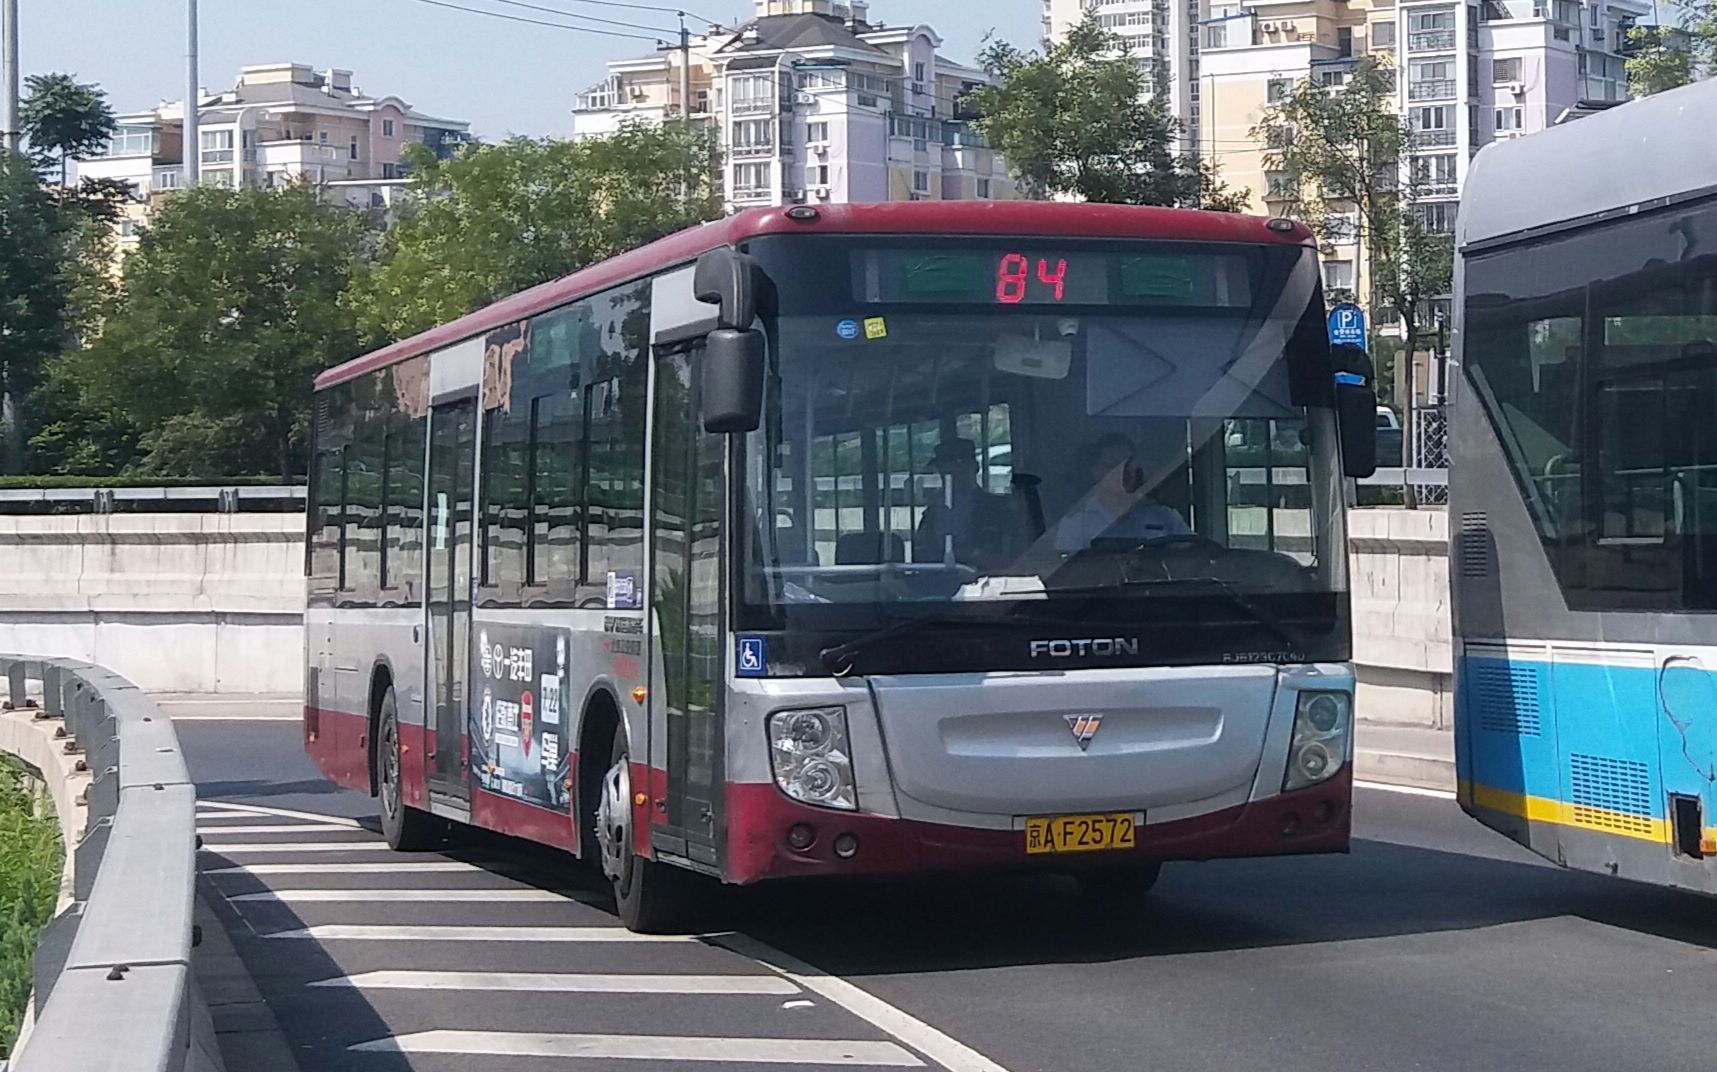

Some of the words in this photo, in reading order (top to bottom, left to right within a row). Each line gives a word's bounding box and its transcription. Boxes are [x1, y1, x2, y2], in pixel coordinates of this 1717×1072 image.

[996, 253, 1067, 303] 84
[1342, 311, 1353, 328] P
[1029, 637, 1139, 657] FOTON
